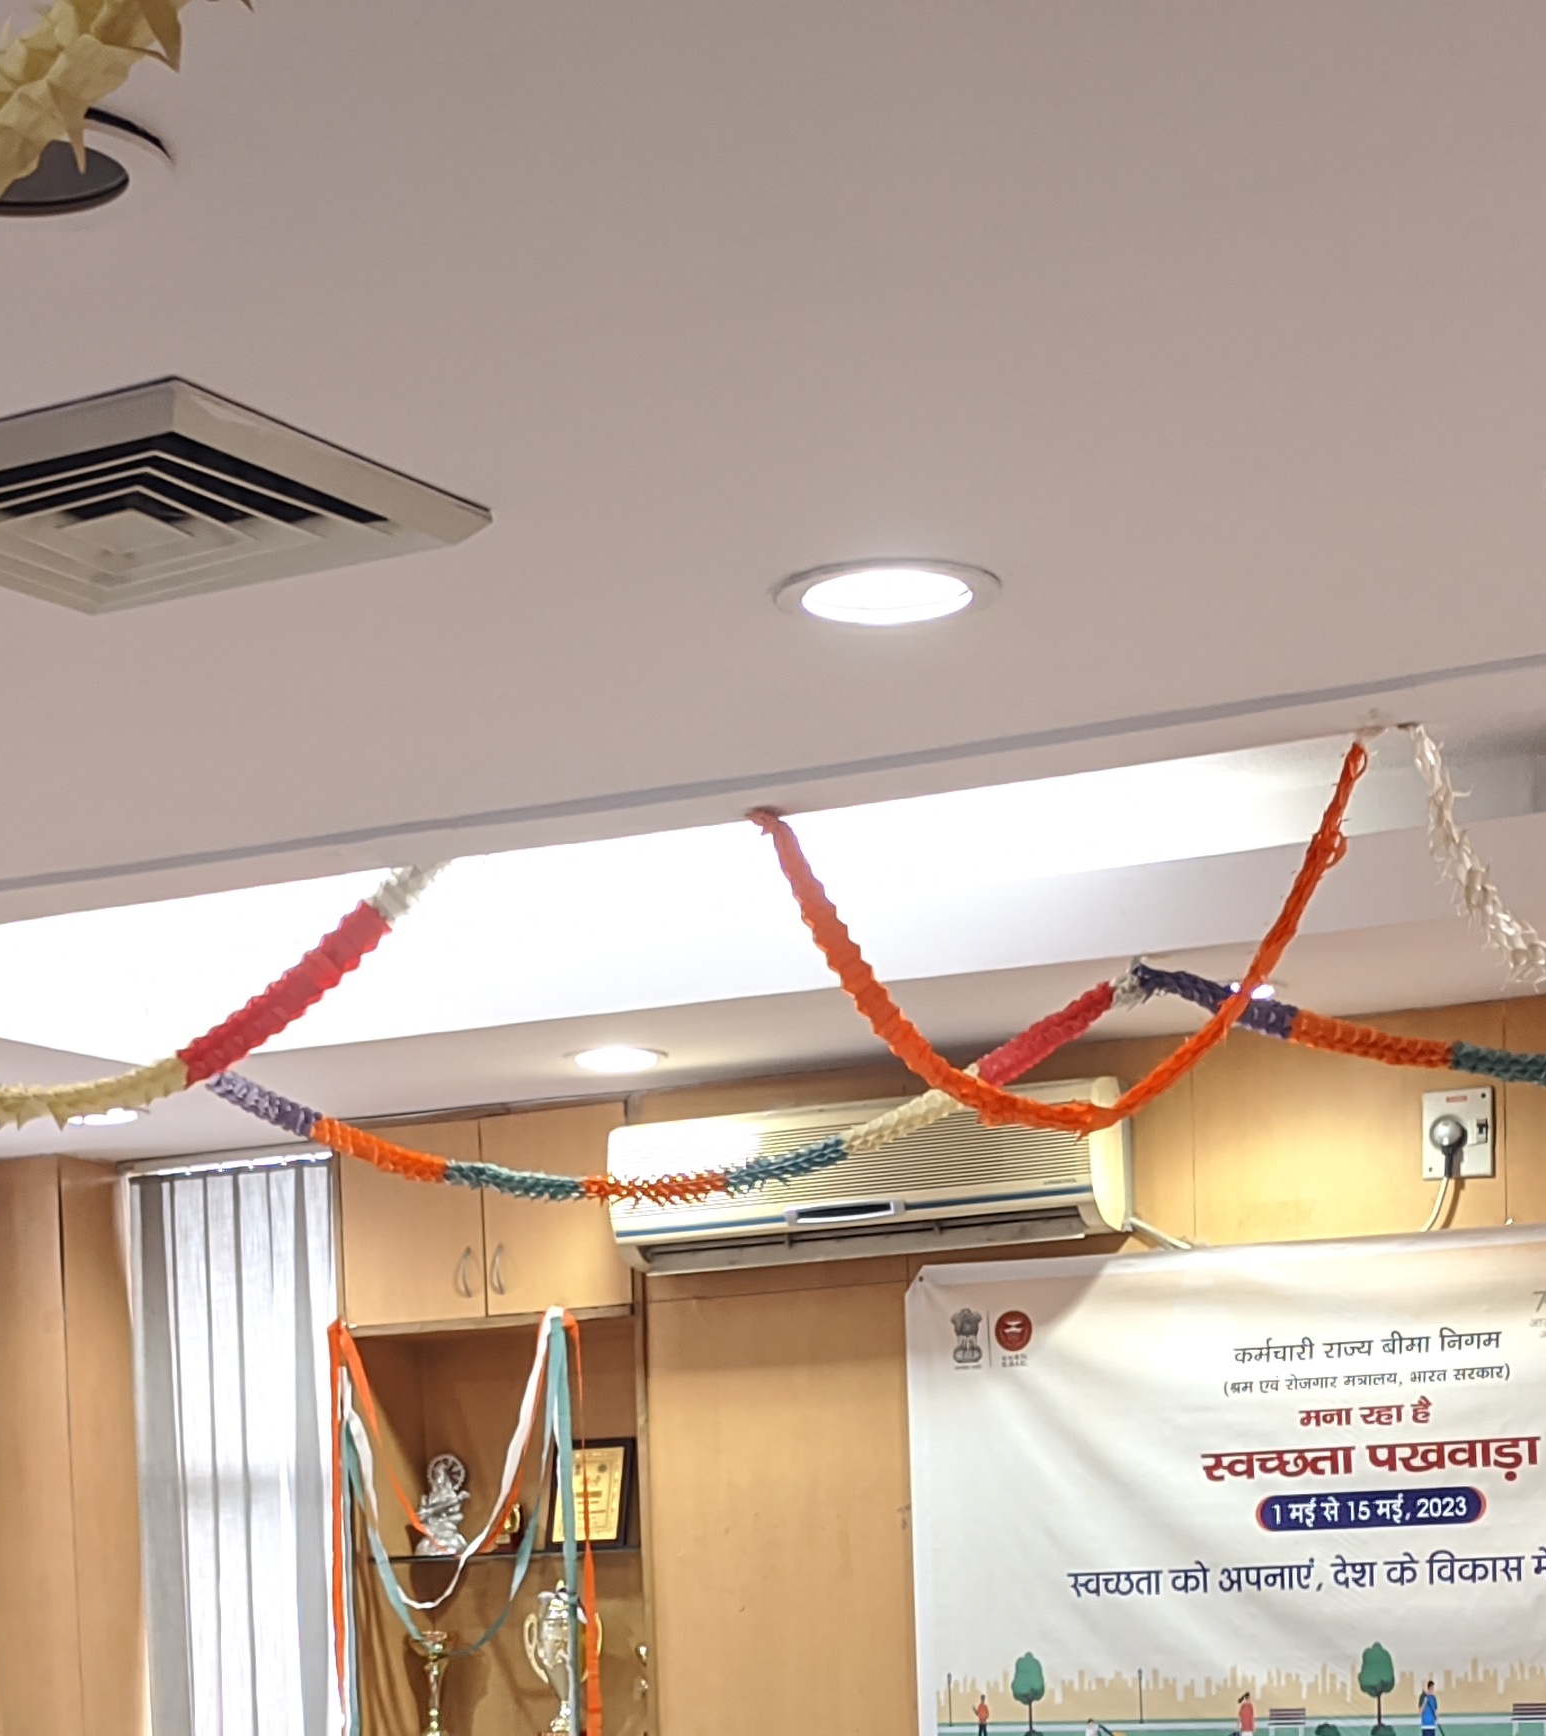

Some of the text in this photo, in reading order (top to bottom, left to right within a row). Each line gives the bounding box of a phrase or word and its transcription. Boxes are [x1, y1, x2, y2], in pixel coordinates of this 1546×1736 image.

[1233, 1327, 1502, 1363] कर्मचारी राज्य बीमा निगम
[1285, 1373, 1337, 1391] रोजगार
[1410, 1369, 1447, 1383] भारत
[1453, 1363, 1510, 1381] सरकार)
[1299, 1396, 1432, 1427] मना रहा है
[1201, 1436, 1541, 1482] स्वच्छता पखवाड़ा
[1272, 1493, 1467, 1527] 1 मई से 15 मई, 2023
[1067, 1570, 1162, 1597] स्वच्छता
[1168, 1561, 1210, 1593] को
[1331, 1555, 1377, 1588] देश
[1383, 1552, 1419, 1586] के
[1426, 1550, 1525, 1585] विकास
